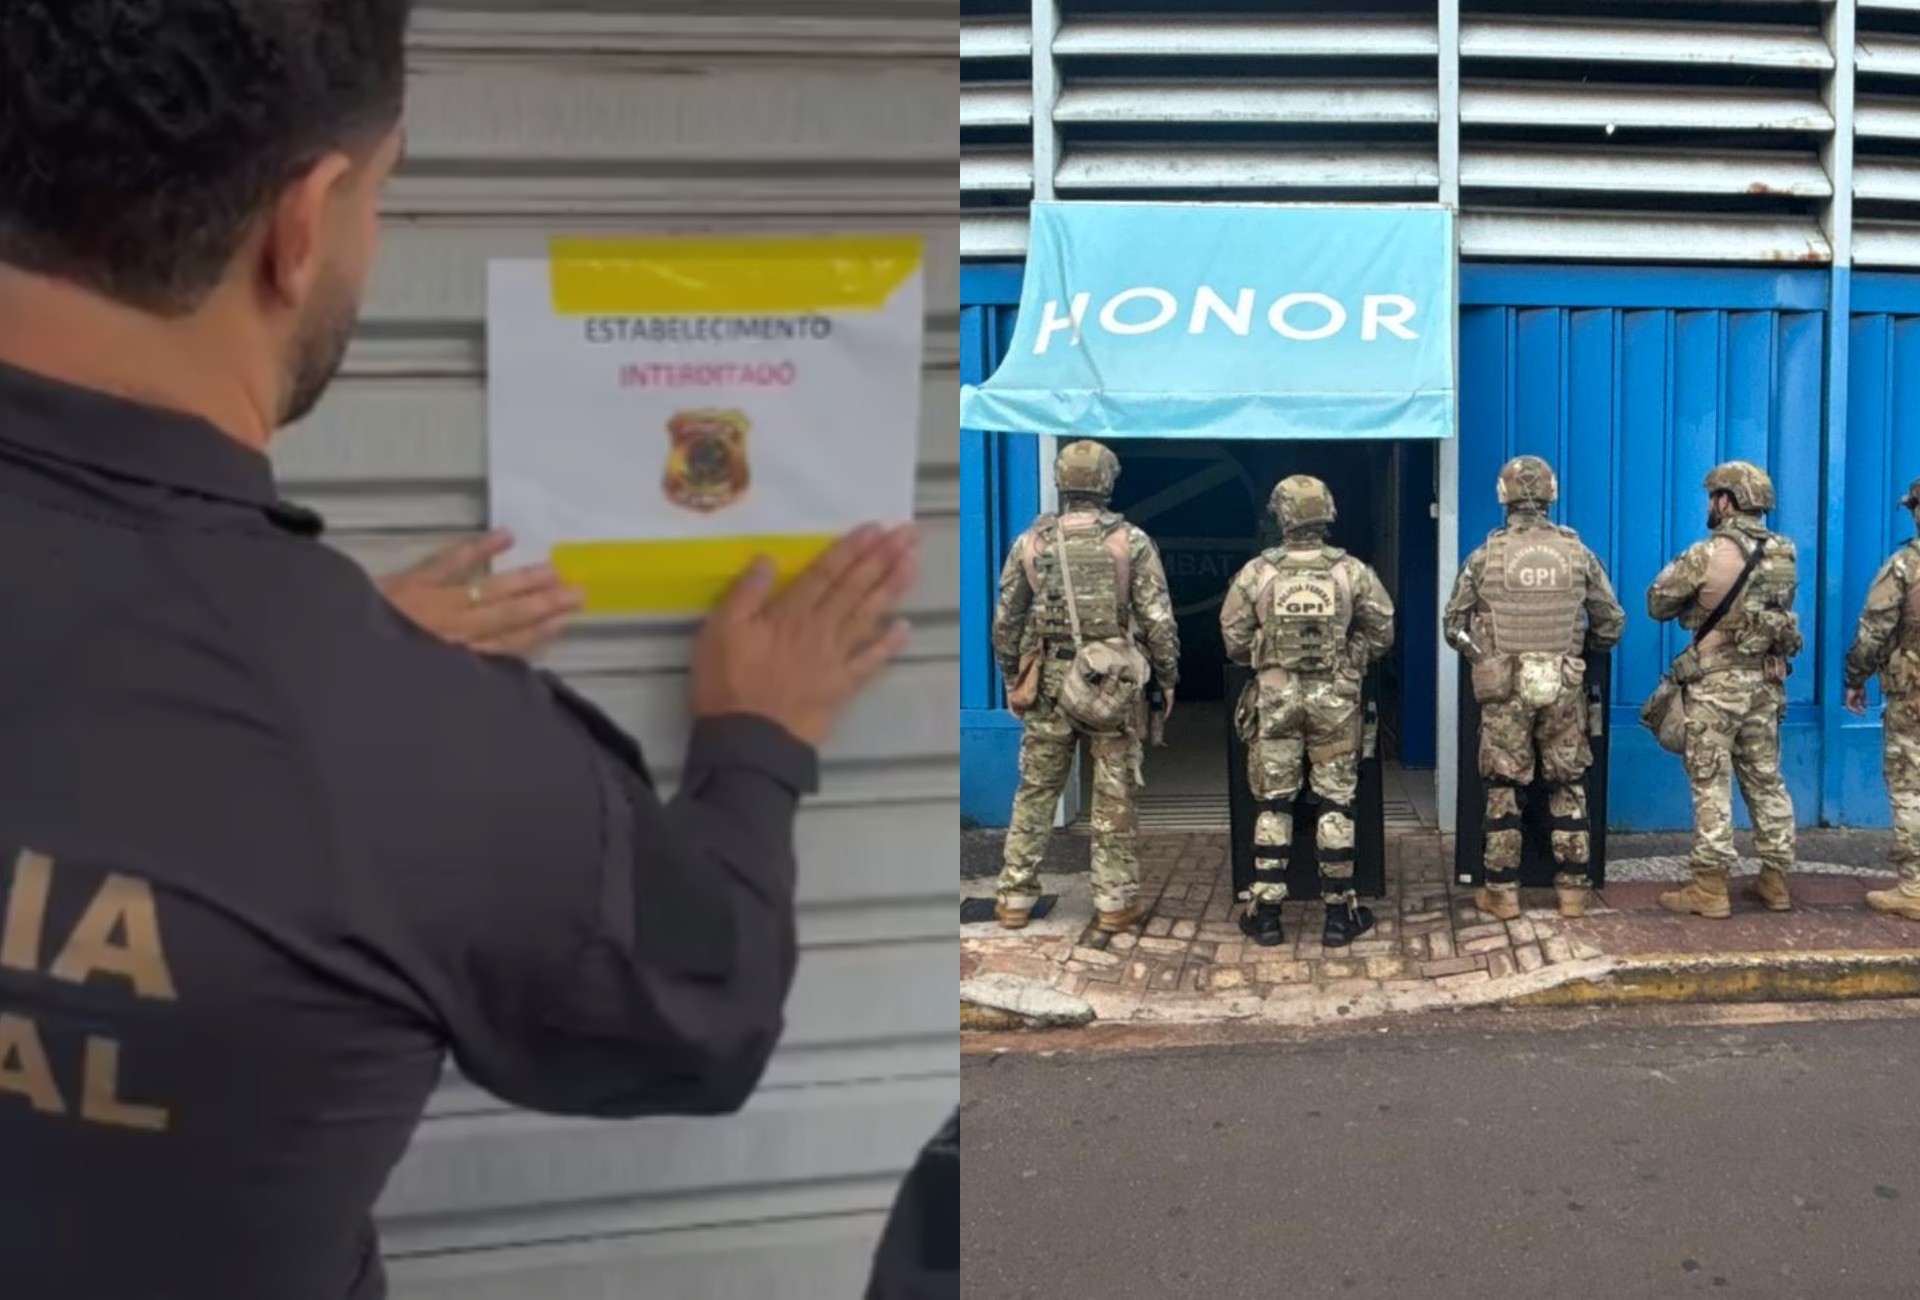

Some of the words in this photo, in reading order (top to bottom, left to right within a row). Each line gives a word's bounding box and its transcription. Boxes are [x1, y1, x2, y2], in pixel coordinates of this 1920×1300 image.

[584, 316, 832, 342] ESTABELECIMENTO
[1032, 285, 1421, 354] HONOR
[619, 361, 795, 387] INTERDITADO
[1520, 568, 1556, 586] GPI
[1287, 603, 1323, 612] GPI
